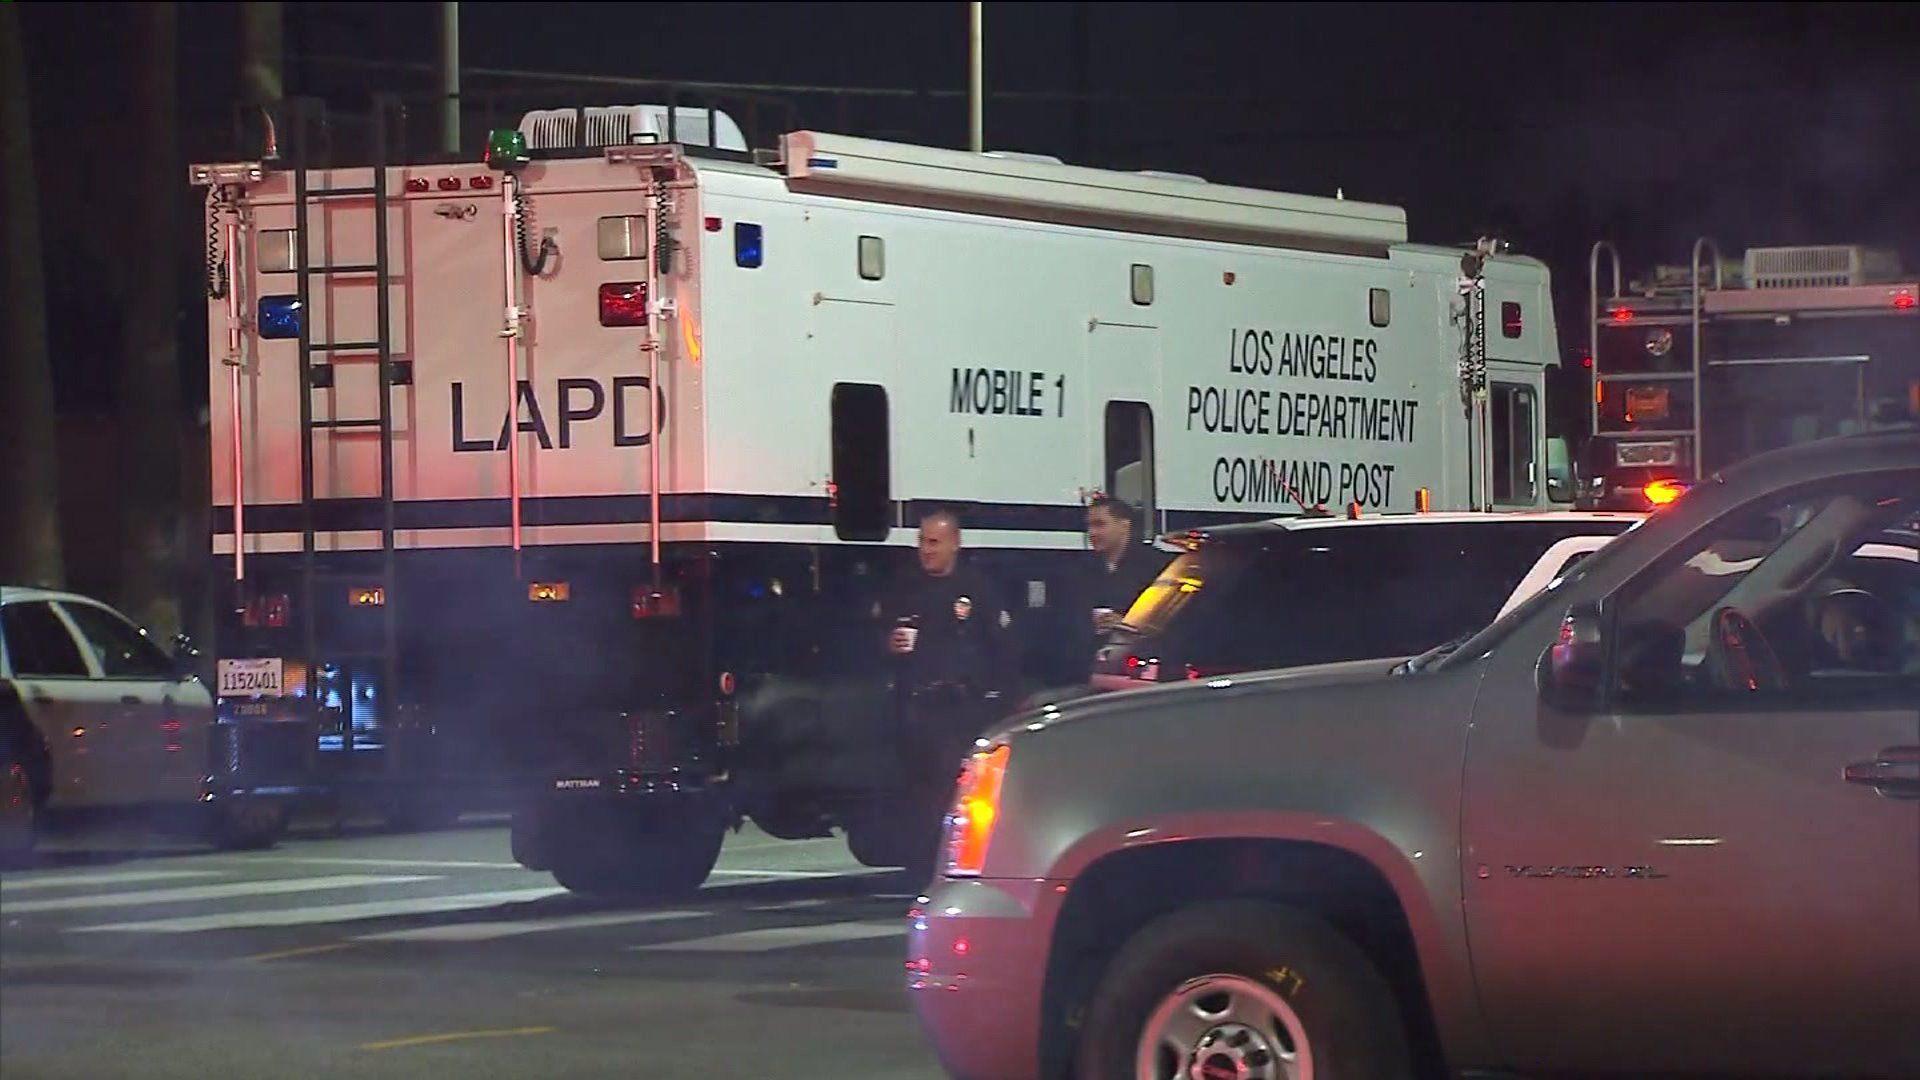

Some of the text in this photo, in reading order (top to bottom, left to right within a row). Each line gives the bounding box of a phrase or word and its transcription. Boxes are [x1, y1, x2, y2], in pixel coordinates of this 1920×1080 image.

[1230, 328, 1377, 383] LOS ANGELES
[451, 376, 666, 452] LAPD
[950, 367, 1066, 418] MOBILE 1
[1187, 386, 1418, 443] POLICE DEPARTMENT
[1213, 457, 1394, 508] COMMAND POST
[223, 672, 278, 690] 1152401
